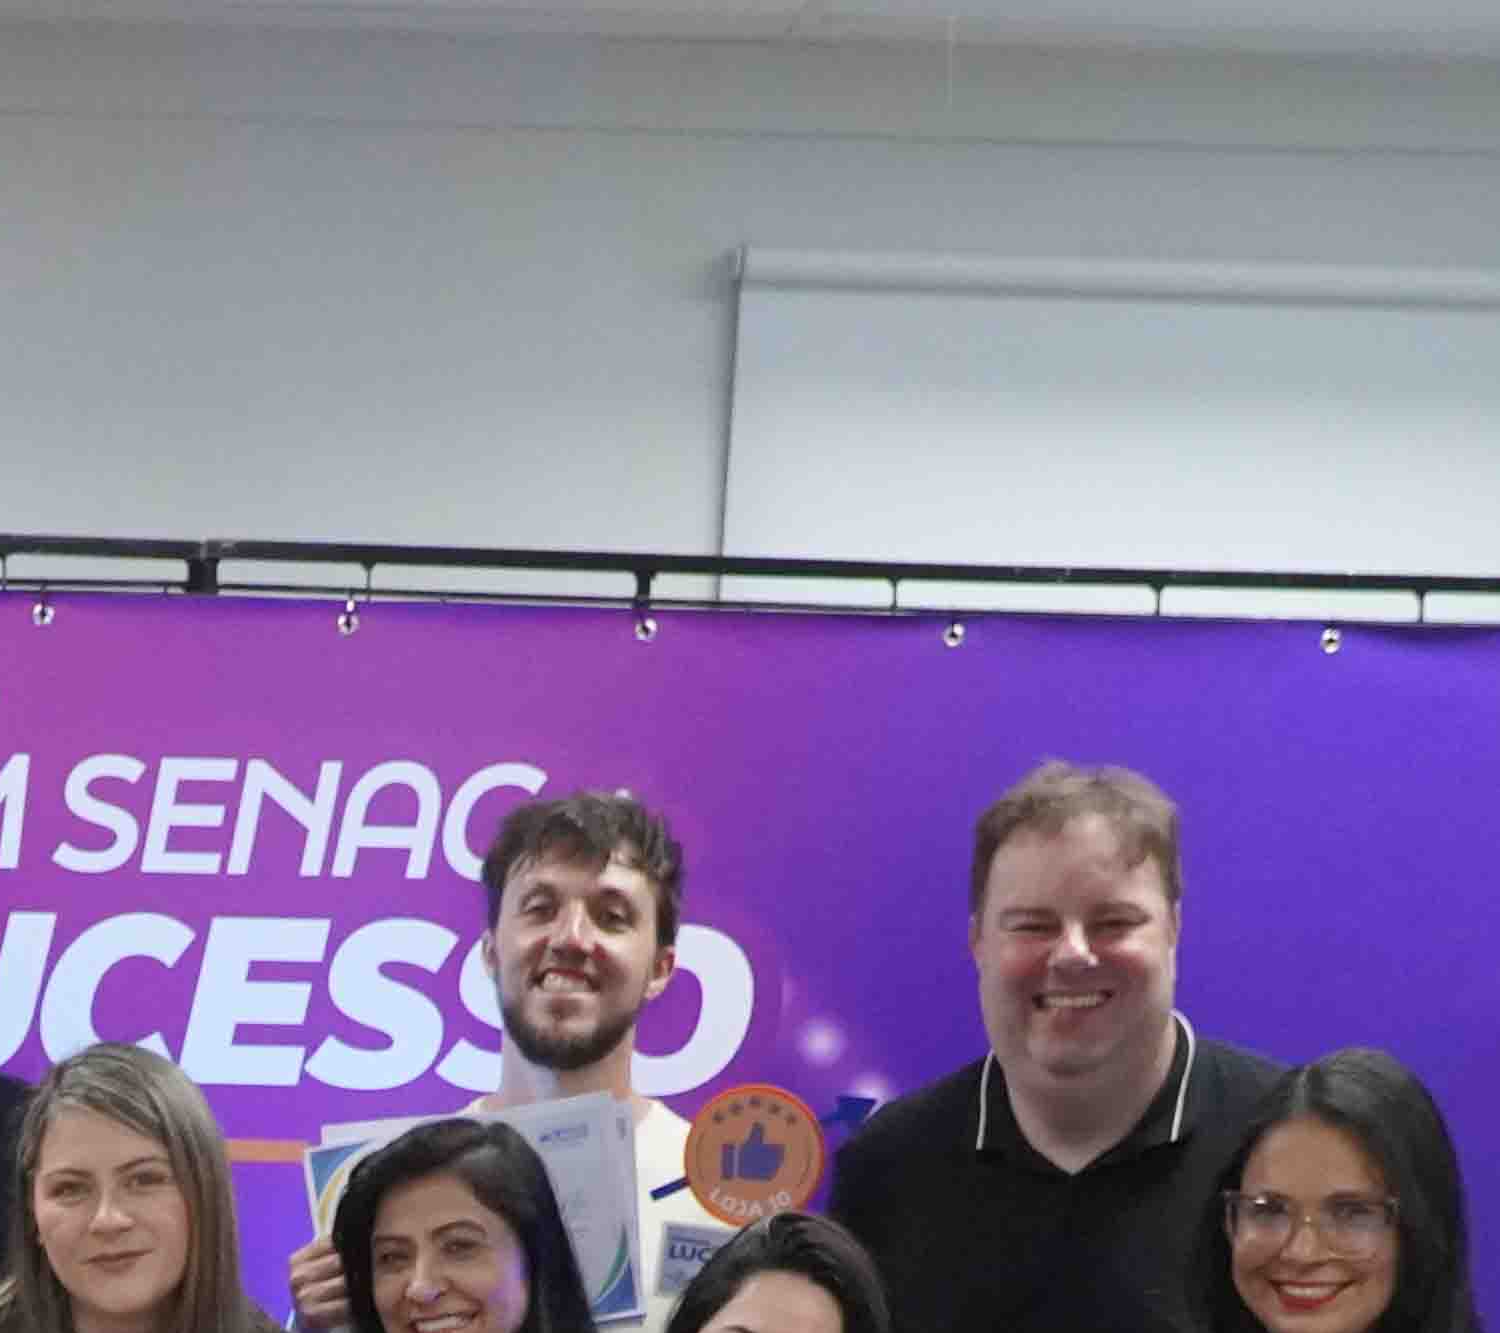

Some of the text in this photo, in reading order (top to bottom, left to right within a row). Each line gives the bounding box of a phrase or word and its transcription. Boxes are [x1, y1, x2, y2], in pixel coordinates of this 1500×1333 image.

[51, 751, 548, 883] SENAC
[708, 1187, 763, 1217] LOJA
[669, 1243, 713, 1264] LUC
